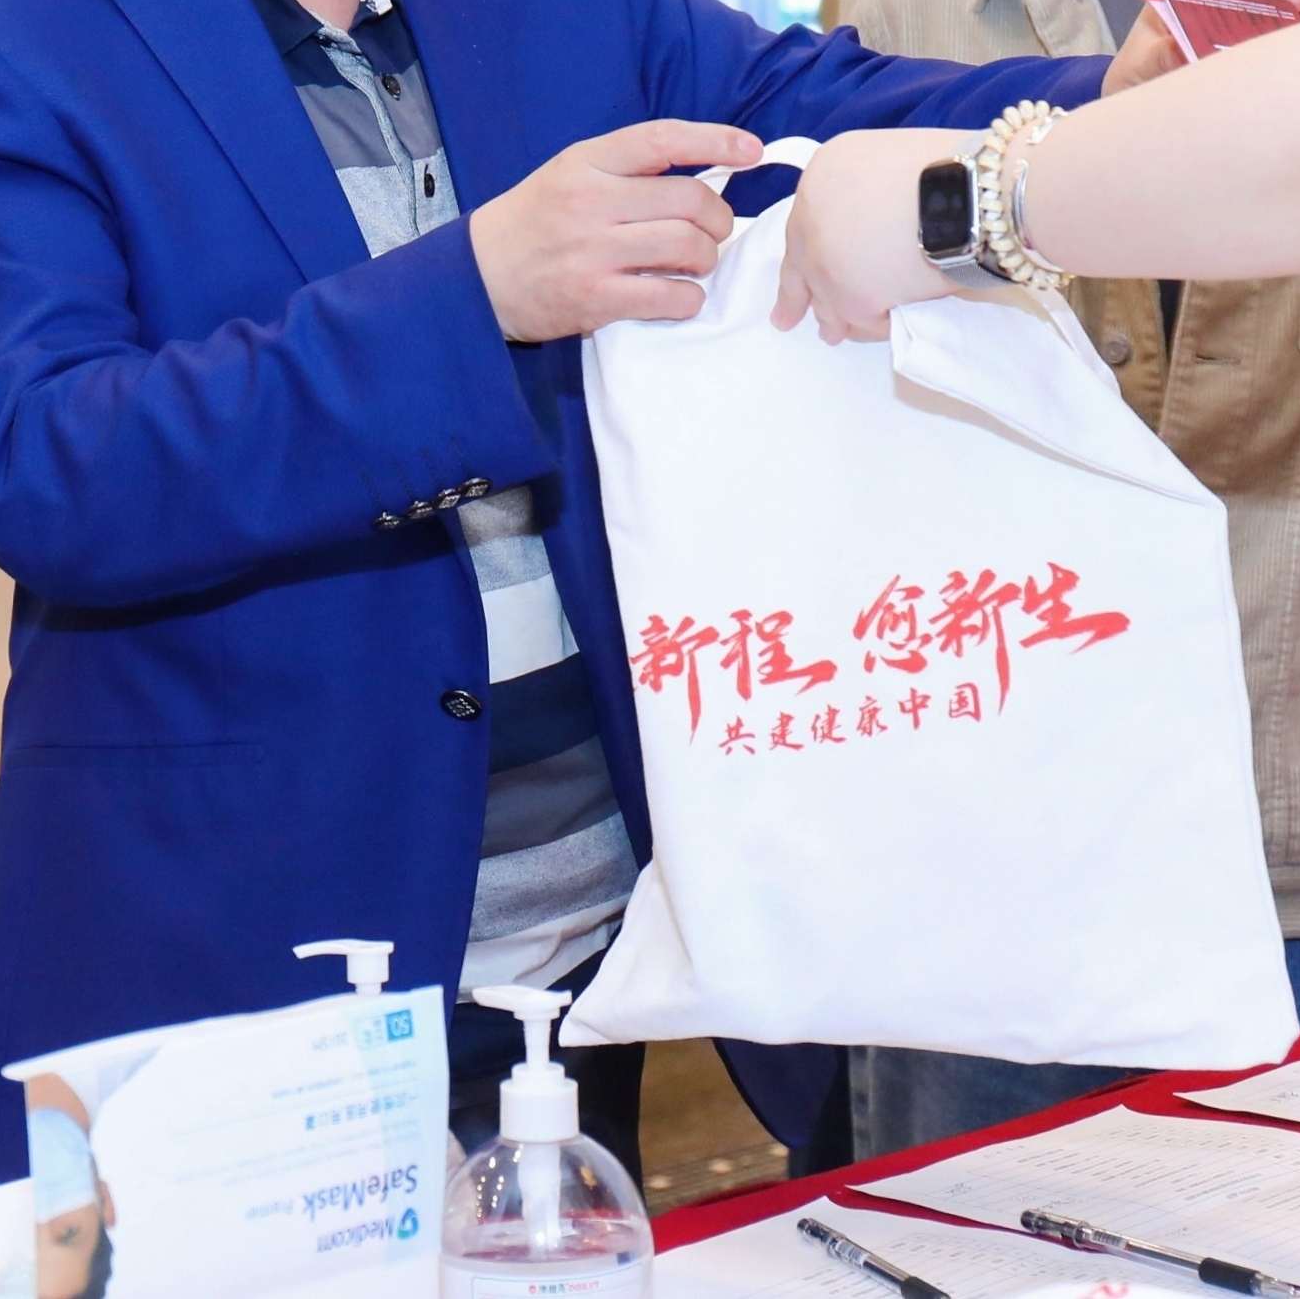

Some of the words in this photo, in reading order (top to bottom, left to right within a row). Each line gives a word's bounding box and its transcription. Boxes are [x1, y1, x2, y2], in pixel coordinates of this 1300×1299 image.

[718, 681, 982, 755] 共建健康中国
[302, 1165, 418, 1220] SafeMask
